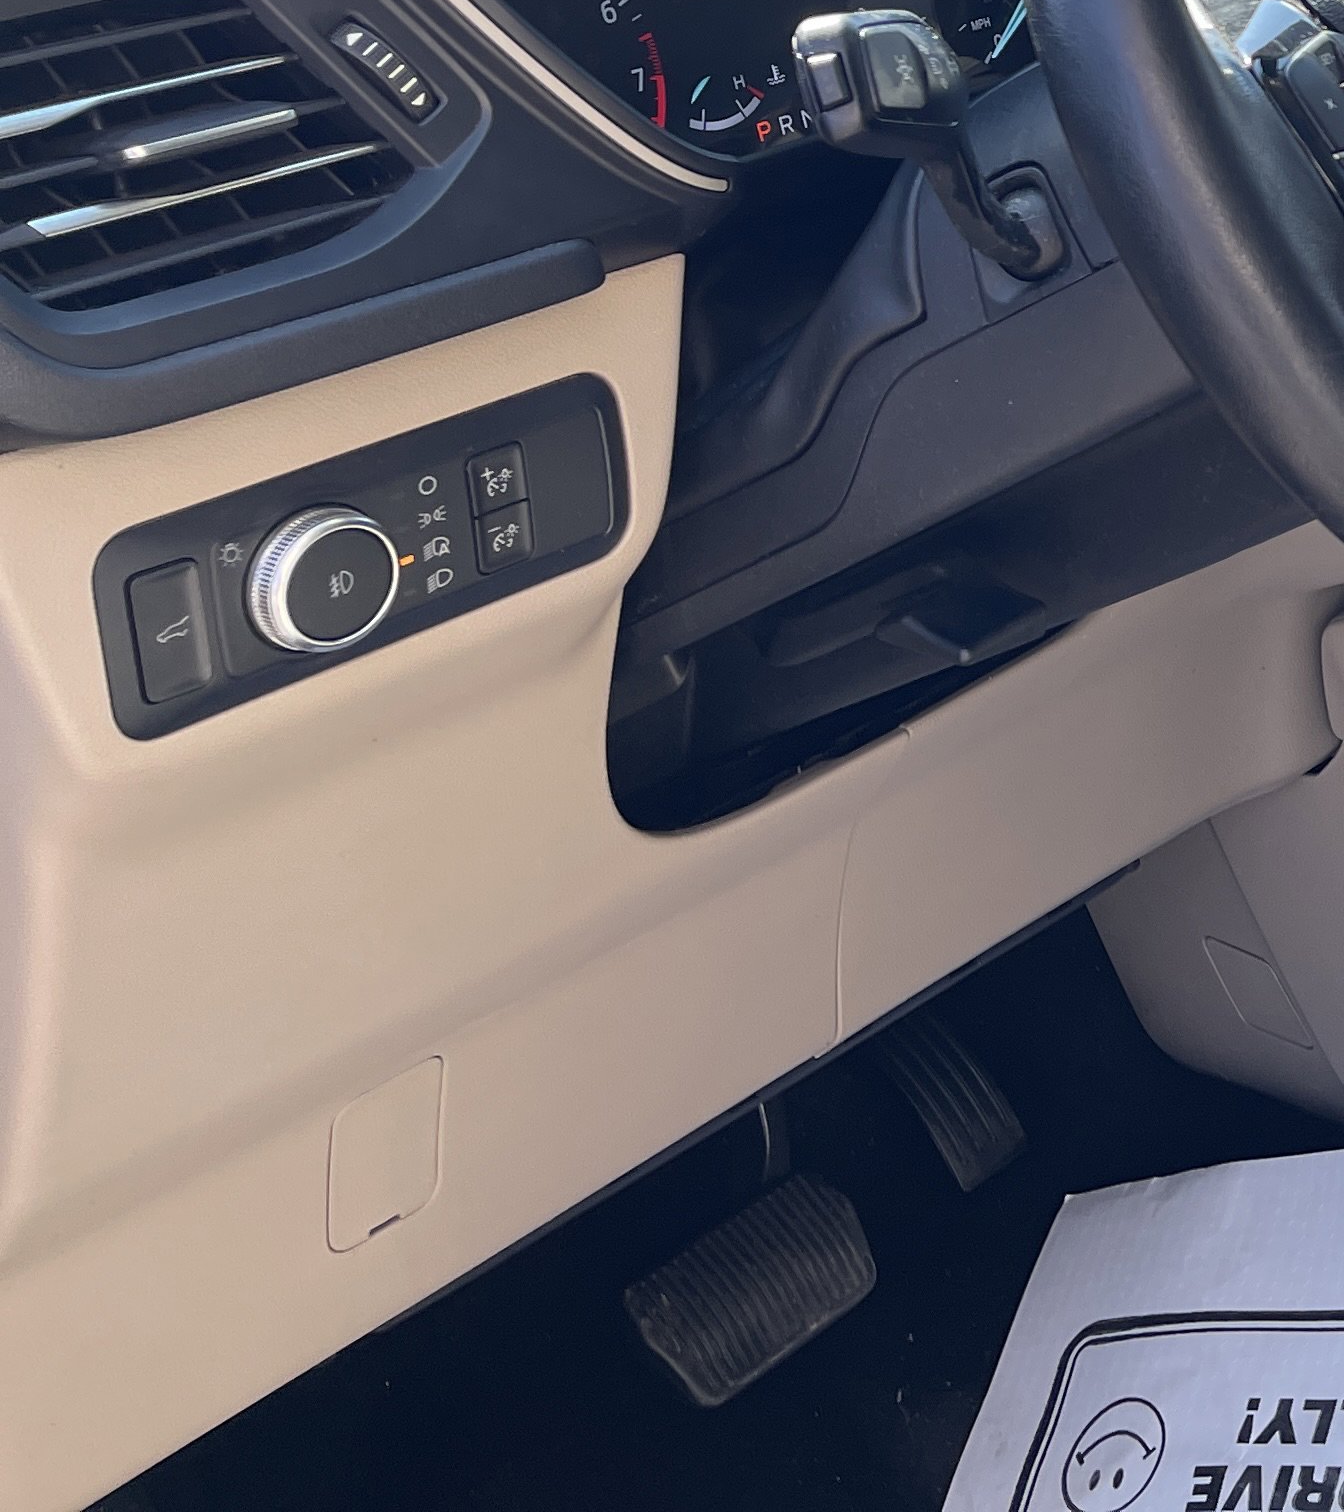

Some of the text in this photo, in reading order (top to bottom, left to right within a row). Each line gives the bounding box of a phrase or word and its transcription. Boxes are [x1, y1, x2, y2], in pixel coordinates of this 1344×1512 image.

[600, 0, 618, 24] 6
[970, 16, 992, 31] MPH
[630, 66, 644, 92] 7
[732, 74, 746, 90] H
[756, 119, 772, 143] P
[778, 114, 795, 136] R
